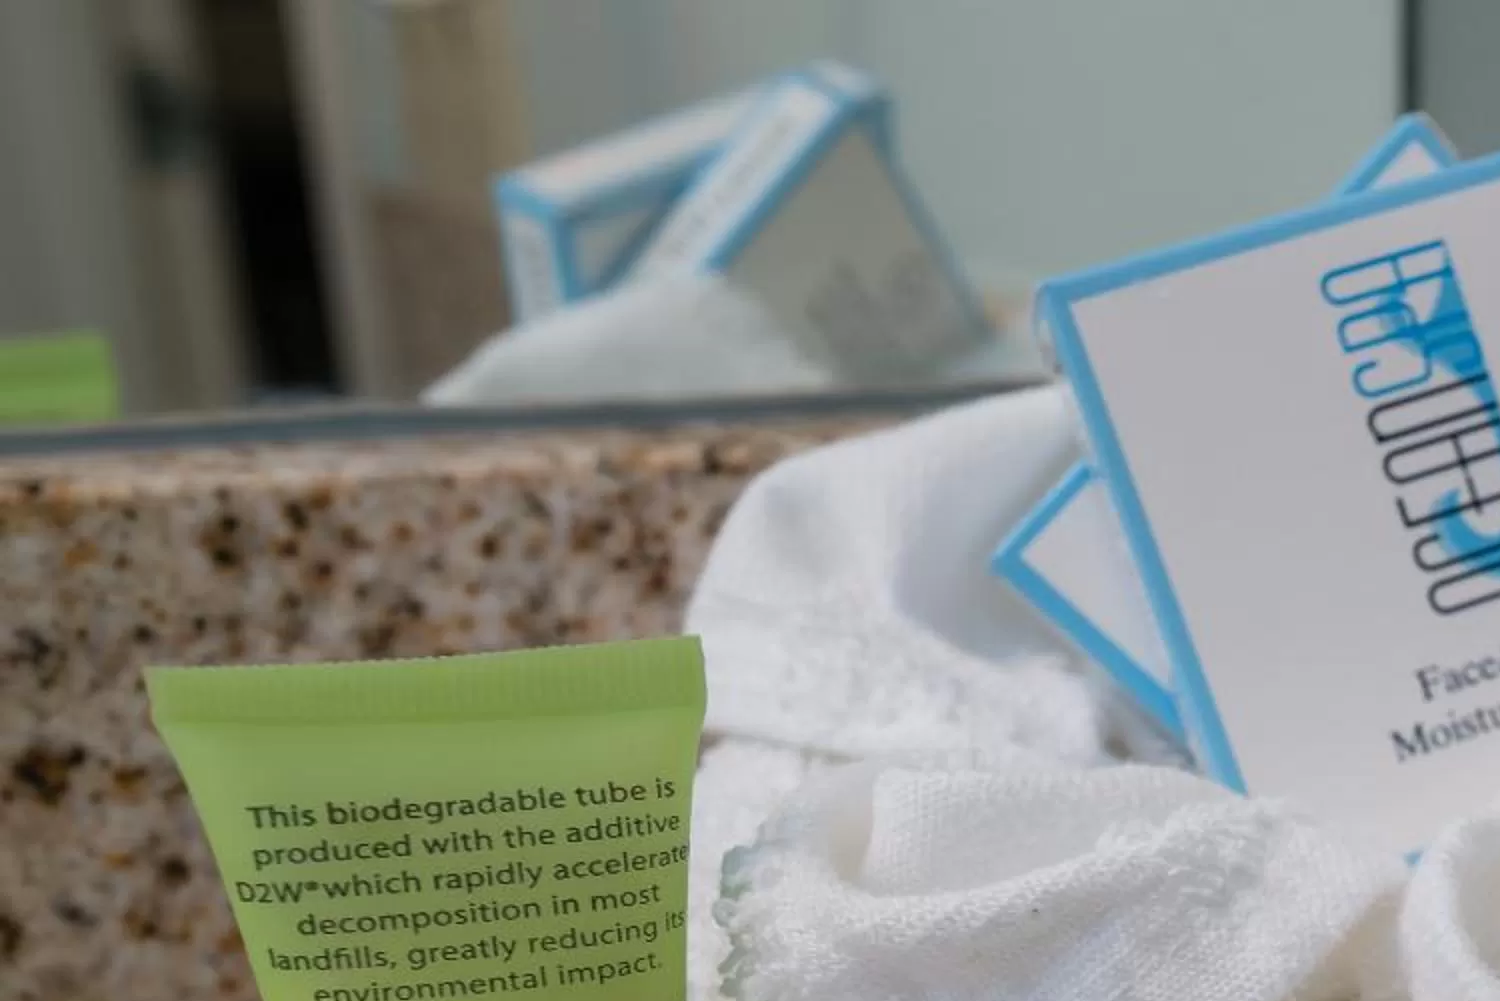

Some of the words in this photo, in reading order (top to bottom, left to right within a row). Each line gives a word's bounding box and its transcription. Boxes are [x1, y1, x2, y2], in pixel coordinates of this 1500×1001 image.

[244, 804, 317, 829] This
[326, 787, 566, 825] biodegradable
[575, 781, 647, 807] tube
[655, 777, 675, 800] is
[253, 834, 412, 871] produced
[422, 829, 493, 855] with
[503, 825, 555, 848] the
[566, 814, 680, 843] additive
[321, 870, 422, 899] which
[433, 861, 543, 894] rapidly
[553, 844, 690, 881] accelerate
[297, 898, 541, 936] decomposition
[552, 895, 579, 917] in
[591, 884, 661, 912] most
[268, 945, 397, 971] landfills,
[407, 936, 516, 971] greatly
[528, 920, 658, 954] reducing
[665, 911, 686, 932] its
[558, 953, 663, 986] impact.
